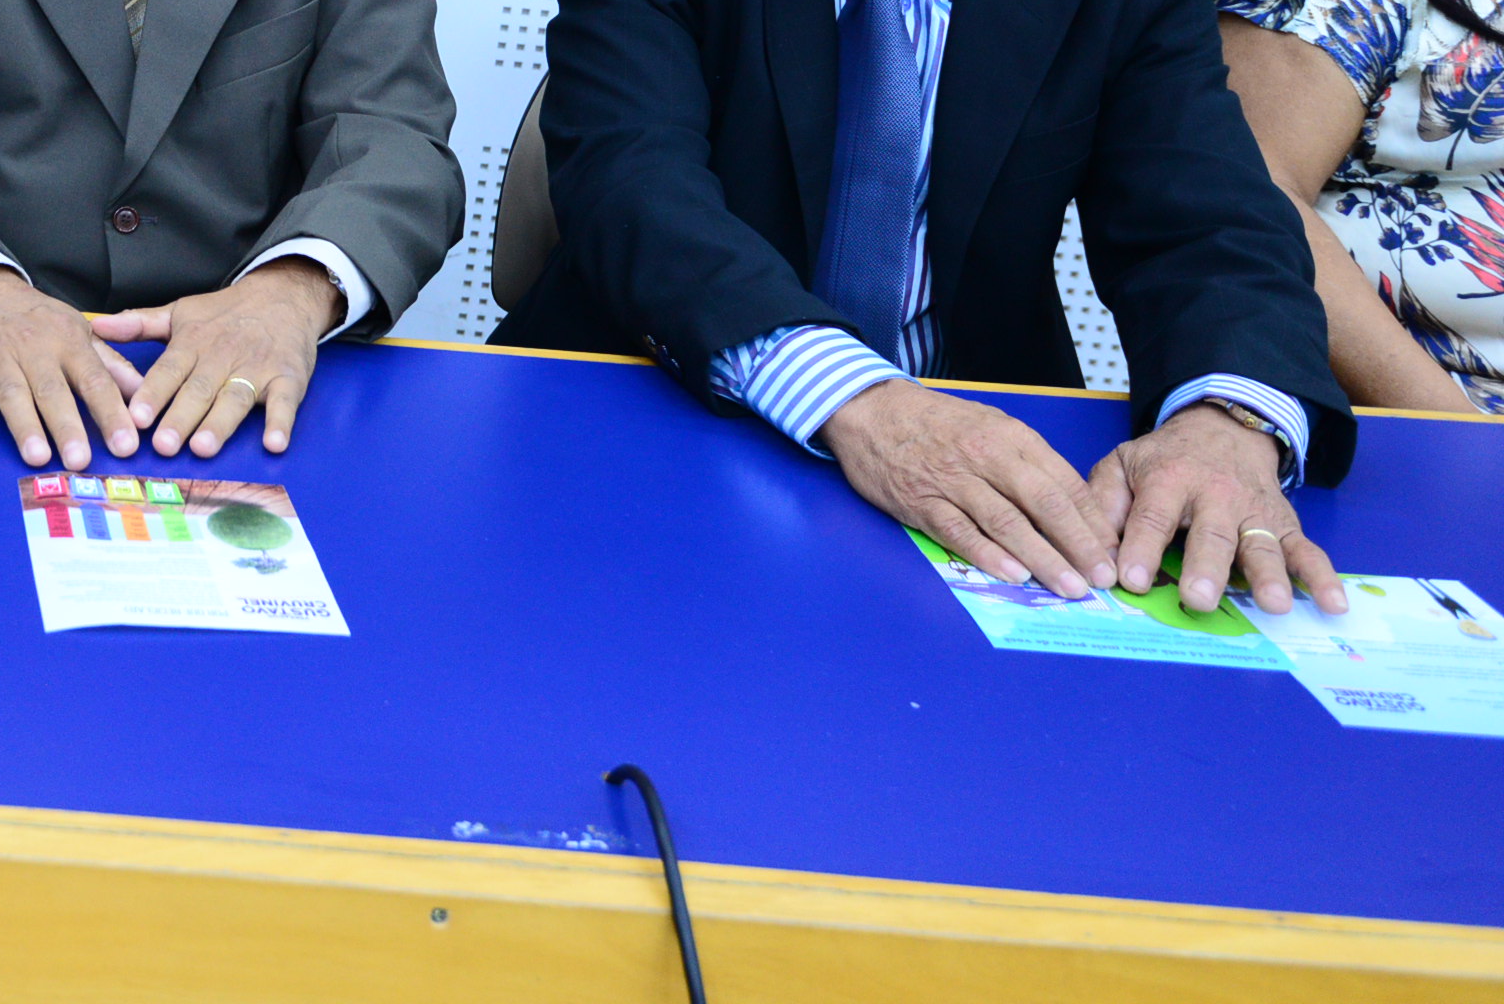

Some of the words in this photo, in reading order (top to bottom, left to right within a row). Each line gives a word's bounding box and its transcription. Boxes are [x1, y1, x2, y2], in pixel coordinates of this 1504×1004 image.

[237, 597, 327, 609] CRUVINEL
[241, 604, 331, 617] GUSTAVO
[1323, 687, 1416, 702] CRUVINEL
[1334, 696, 1427, 711] GUSTAVO
